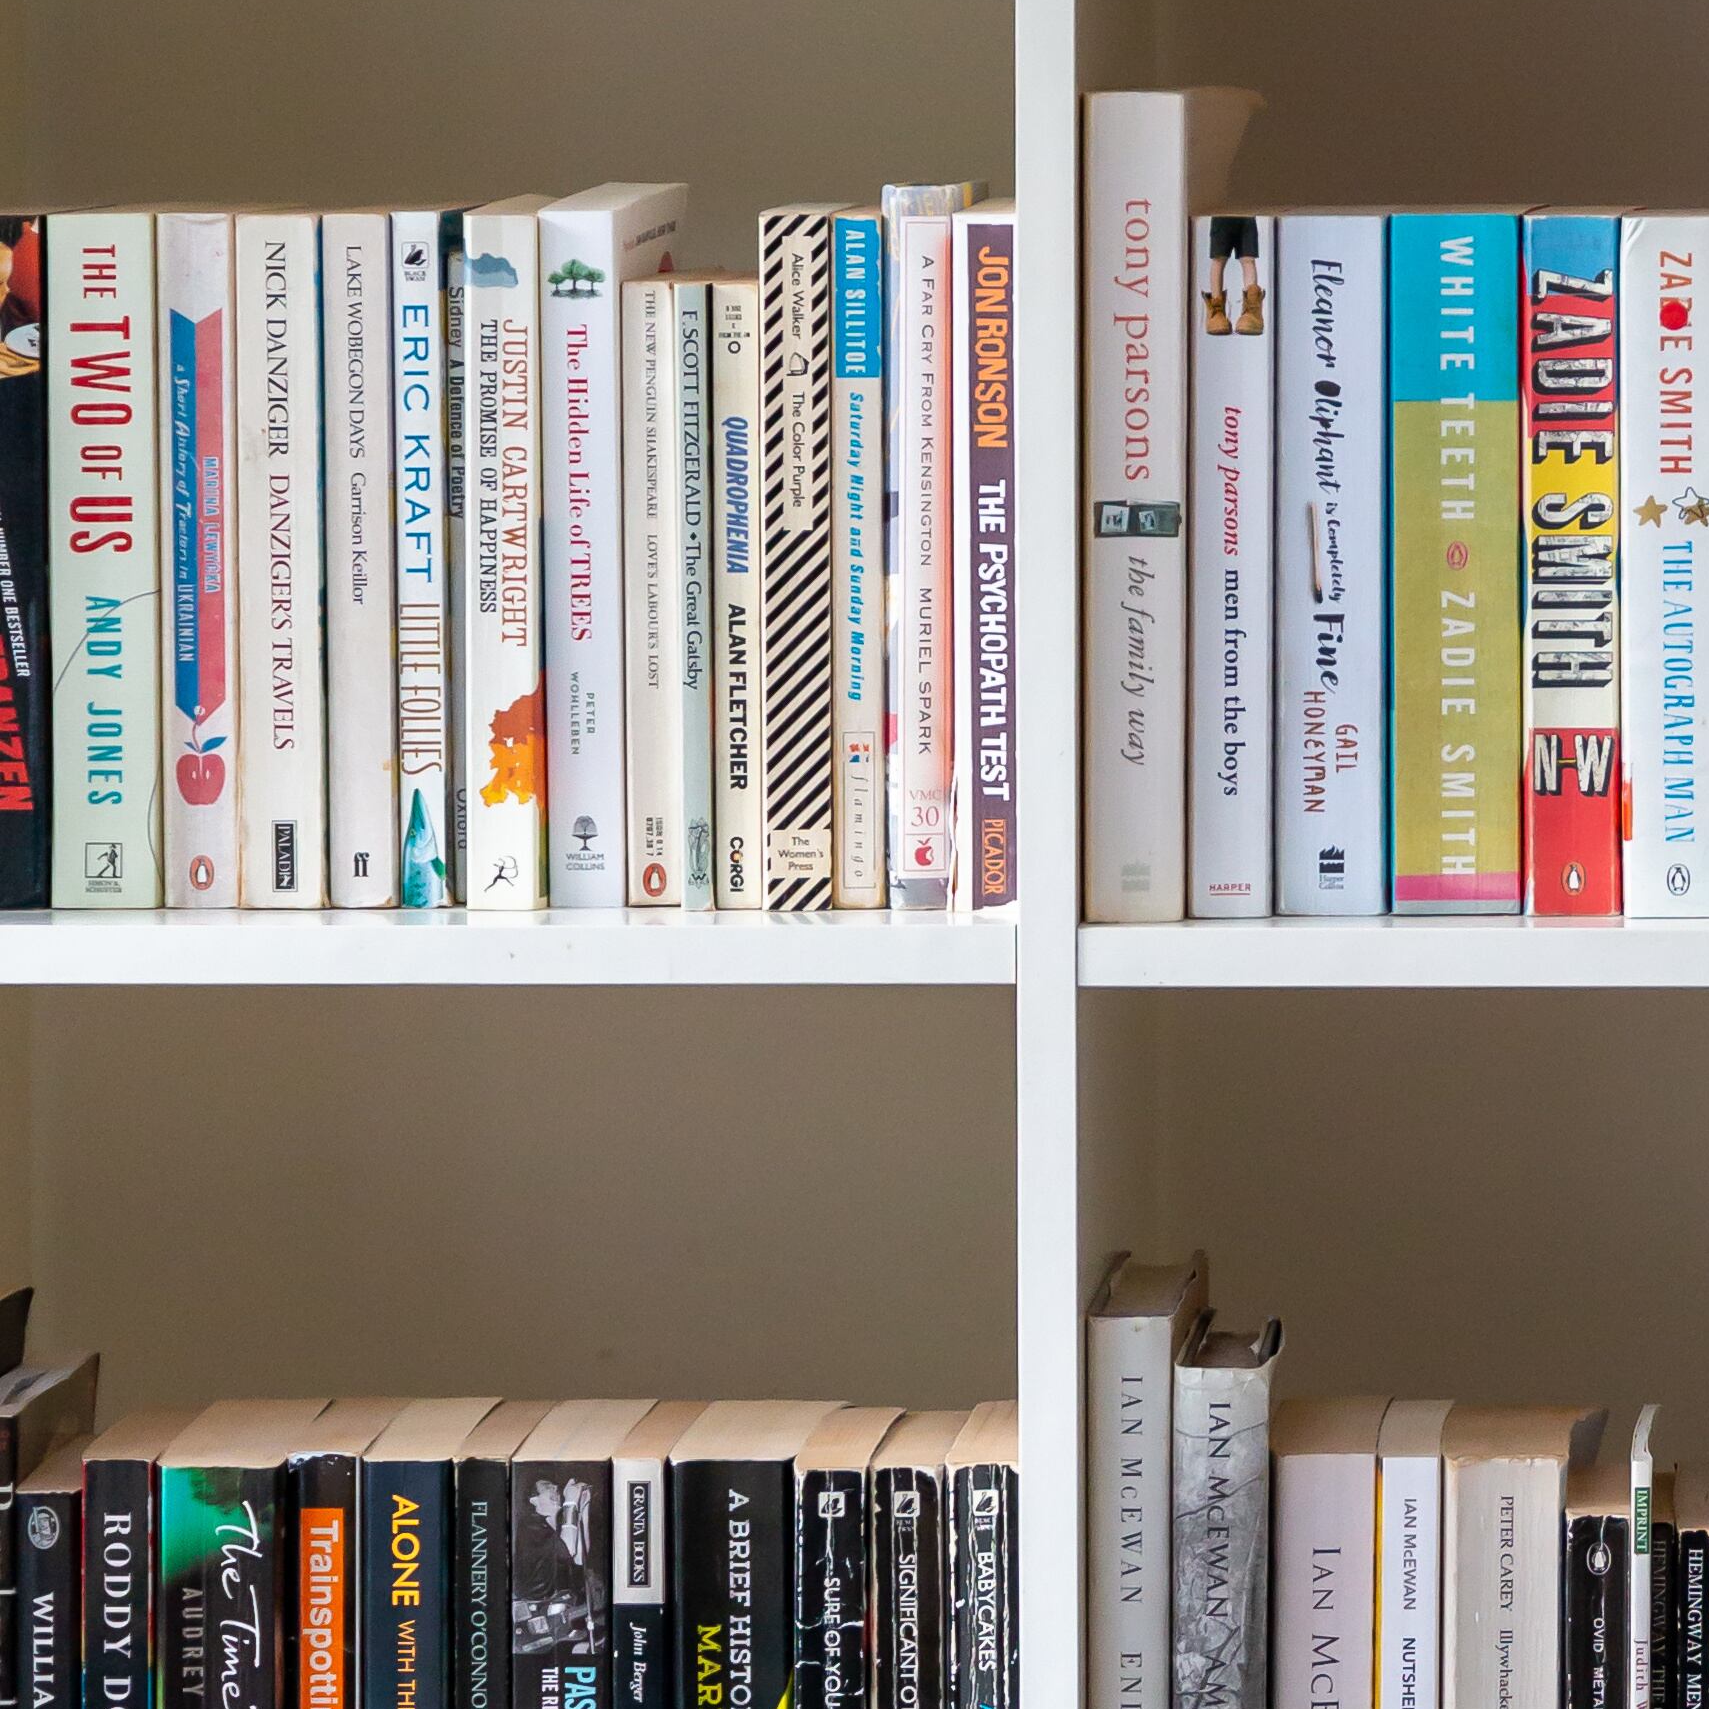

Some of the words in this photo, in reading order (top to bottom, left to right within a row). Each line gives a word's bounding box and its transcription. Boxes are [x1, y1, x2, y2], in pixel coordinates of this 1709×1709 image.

[346, 245, 363, 296] LAKE
[791, 253, 806, 287] Alice
[791, 293, 806, 339] Walker
[346, 302, 364, 406] WOBEGON
[790, 392, 805, 418] The
[349, 411, 366, 458] DAYS
[791, 422, 806, 459] Color
[350, 472, 367, 544] Garrison
[725, 416, 748, 574] QUADROPHENIA
[788, 464, 806, 508] Purple
[352, 550, 369, 605] Keillor
[729, 603, 746, 666] ALAN
[729, 672, 748, 790] FLETCHER
[729, 836, 744, 892] CORGI
[1499, 1495, 1514, 1550] PETER
[470, 1501, 488, 1607] FLANNERY
[1499, 1554, 1514, 1611] CAREY
